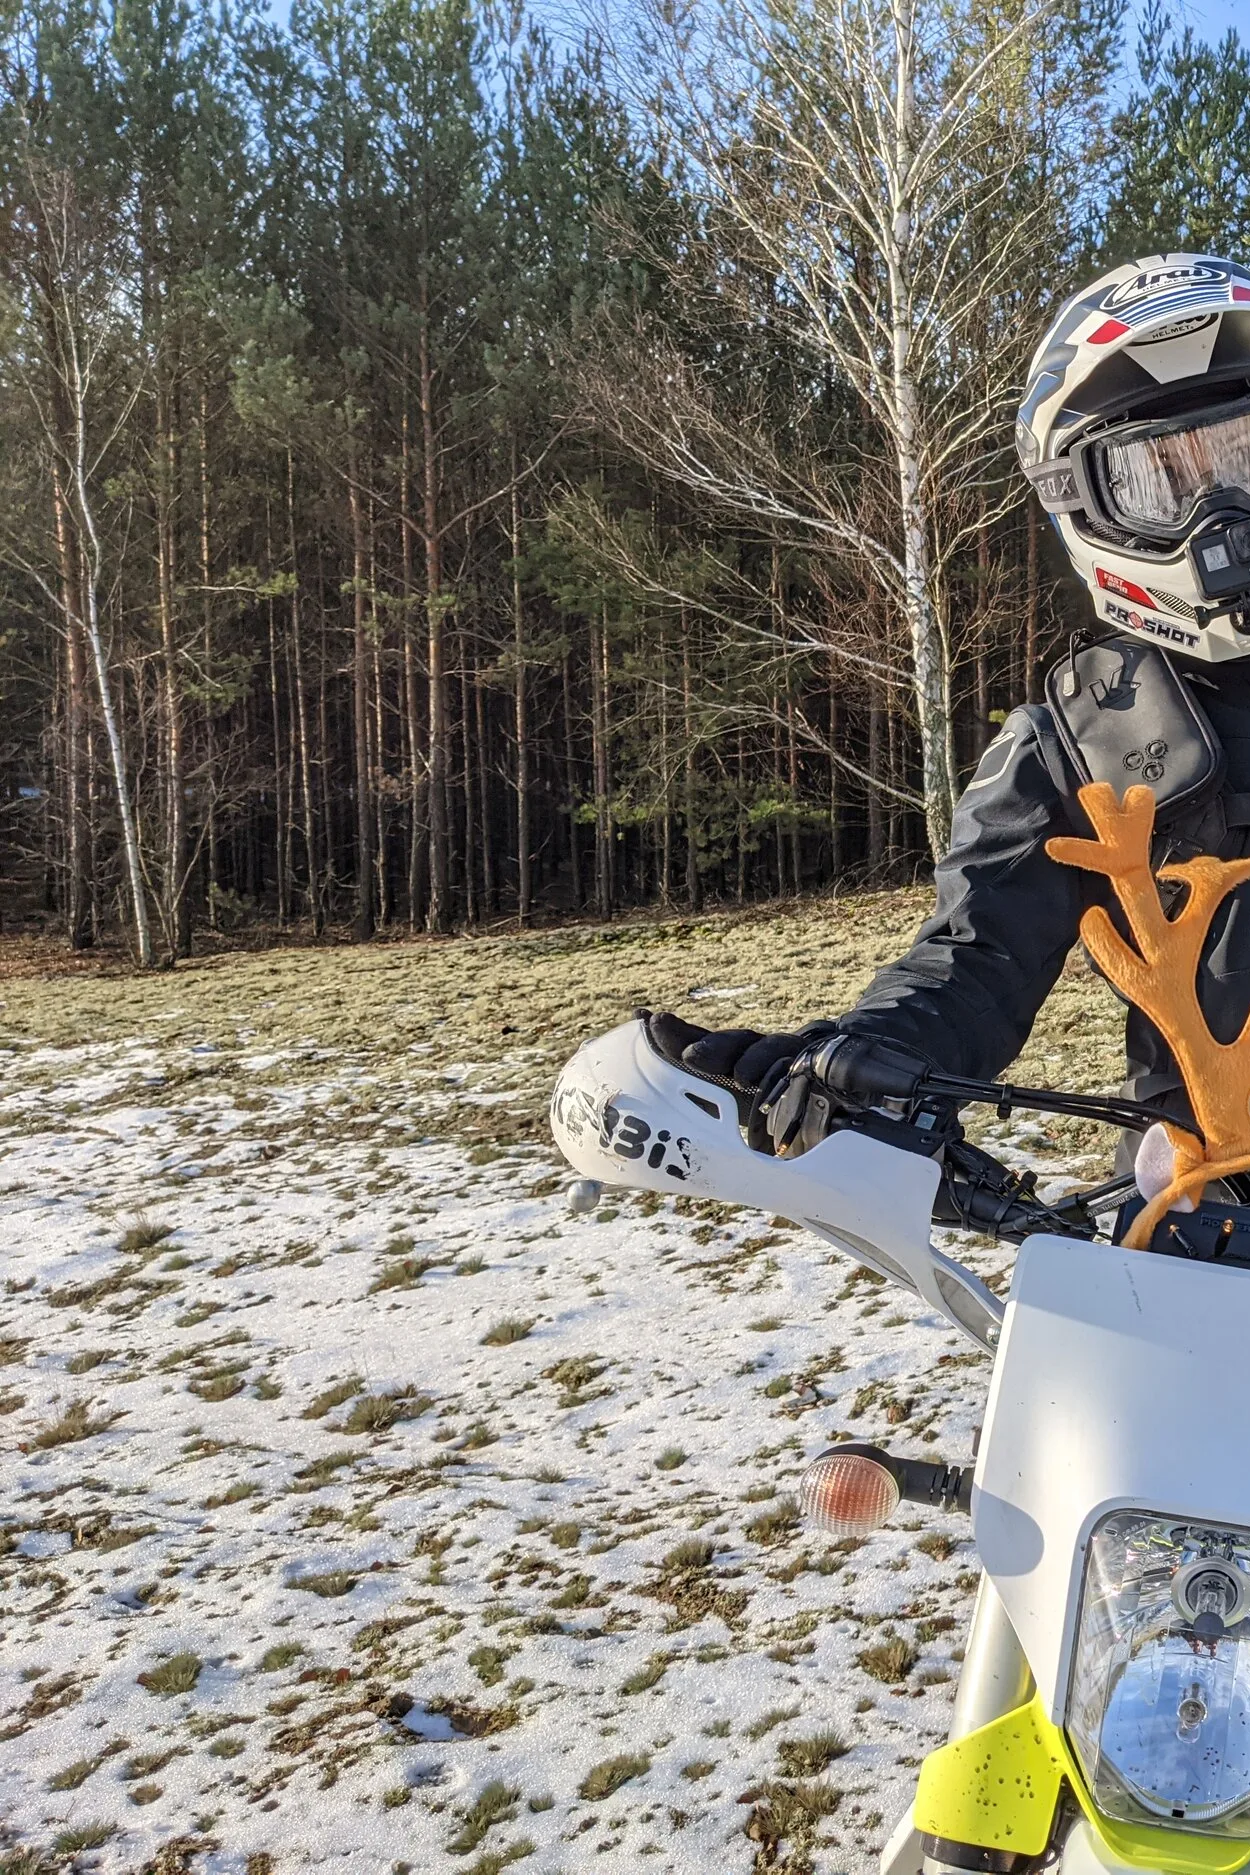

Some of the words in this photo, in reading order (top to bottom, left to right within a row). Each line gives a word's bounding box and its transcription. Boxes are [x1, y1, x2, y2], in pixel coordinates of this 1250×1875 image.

[1117, 268, 1208, 301] Arai
[1152, 325, 1190, 339] HELMET
[1038, 473, 1071, 497] FOX
